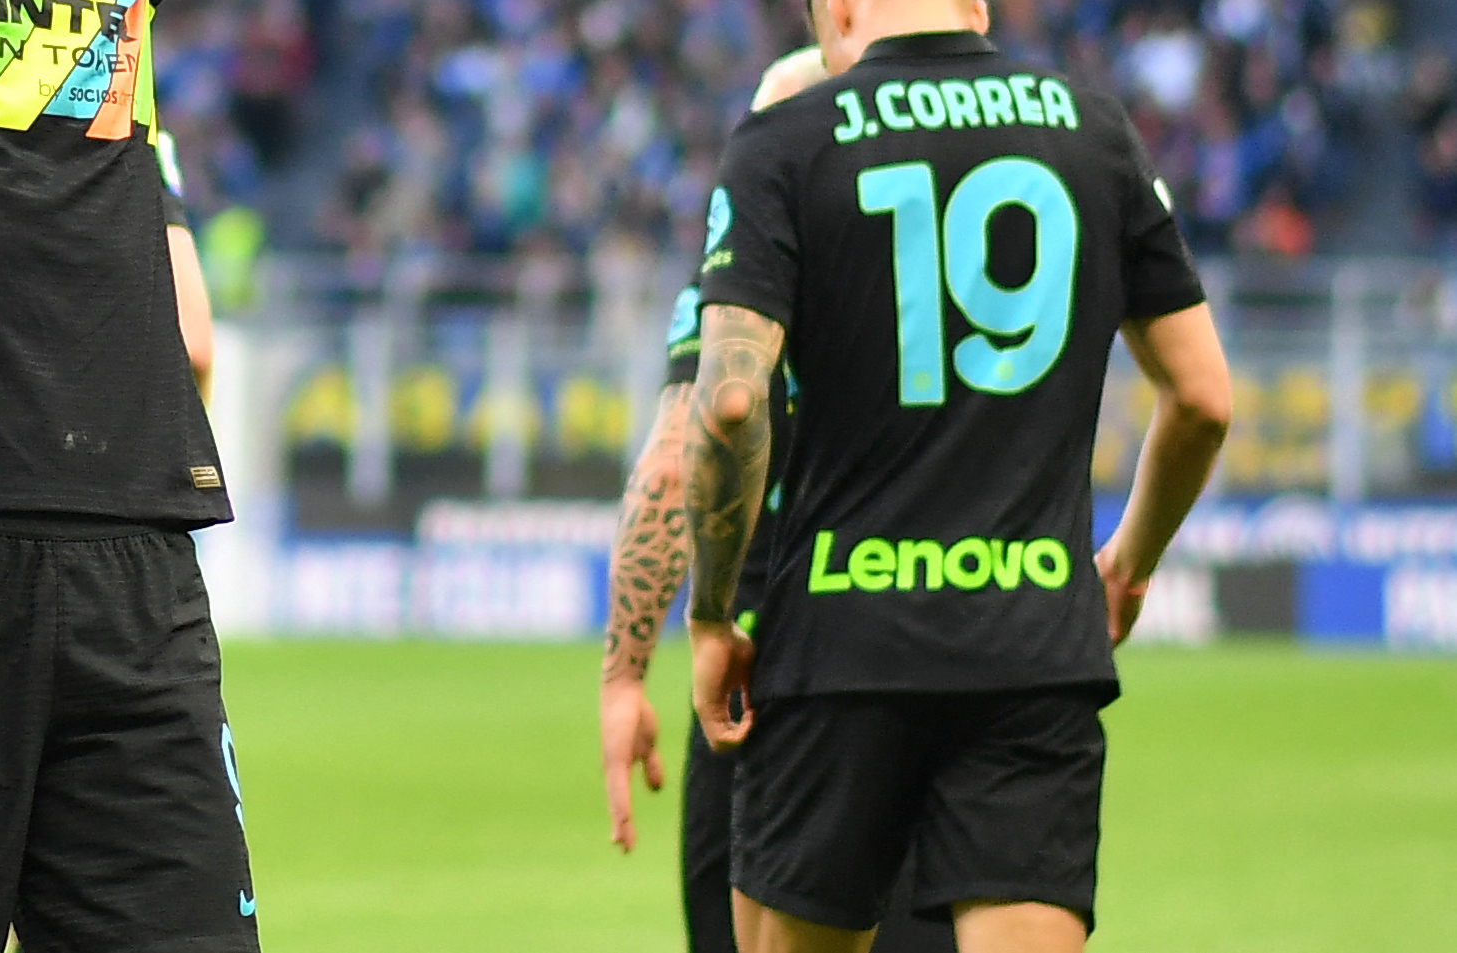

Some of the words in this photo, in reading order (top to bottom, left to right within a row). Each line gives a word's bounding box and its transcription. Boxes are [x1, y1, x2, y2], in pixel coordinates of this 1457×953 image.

[38, 78, 63, 102] by
[834, 74, 1079, 143] J.CORREA
[856, 155, 1080, 407] 19
[808, 531, 1071, 594] Lenovo
